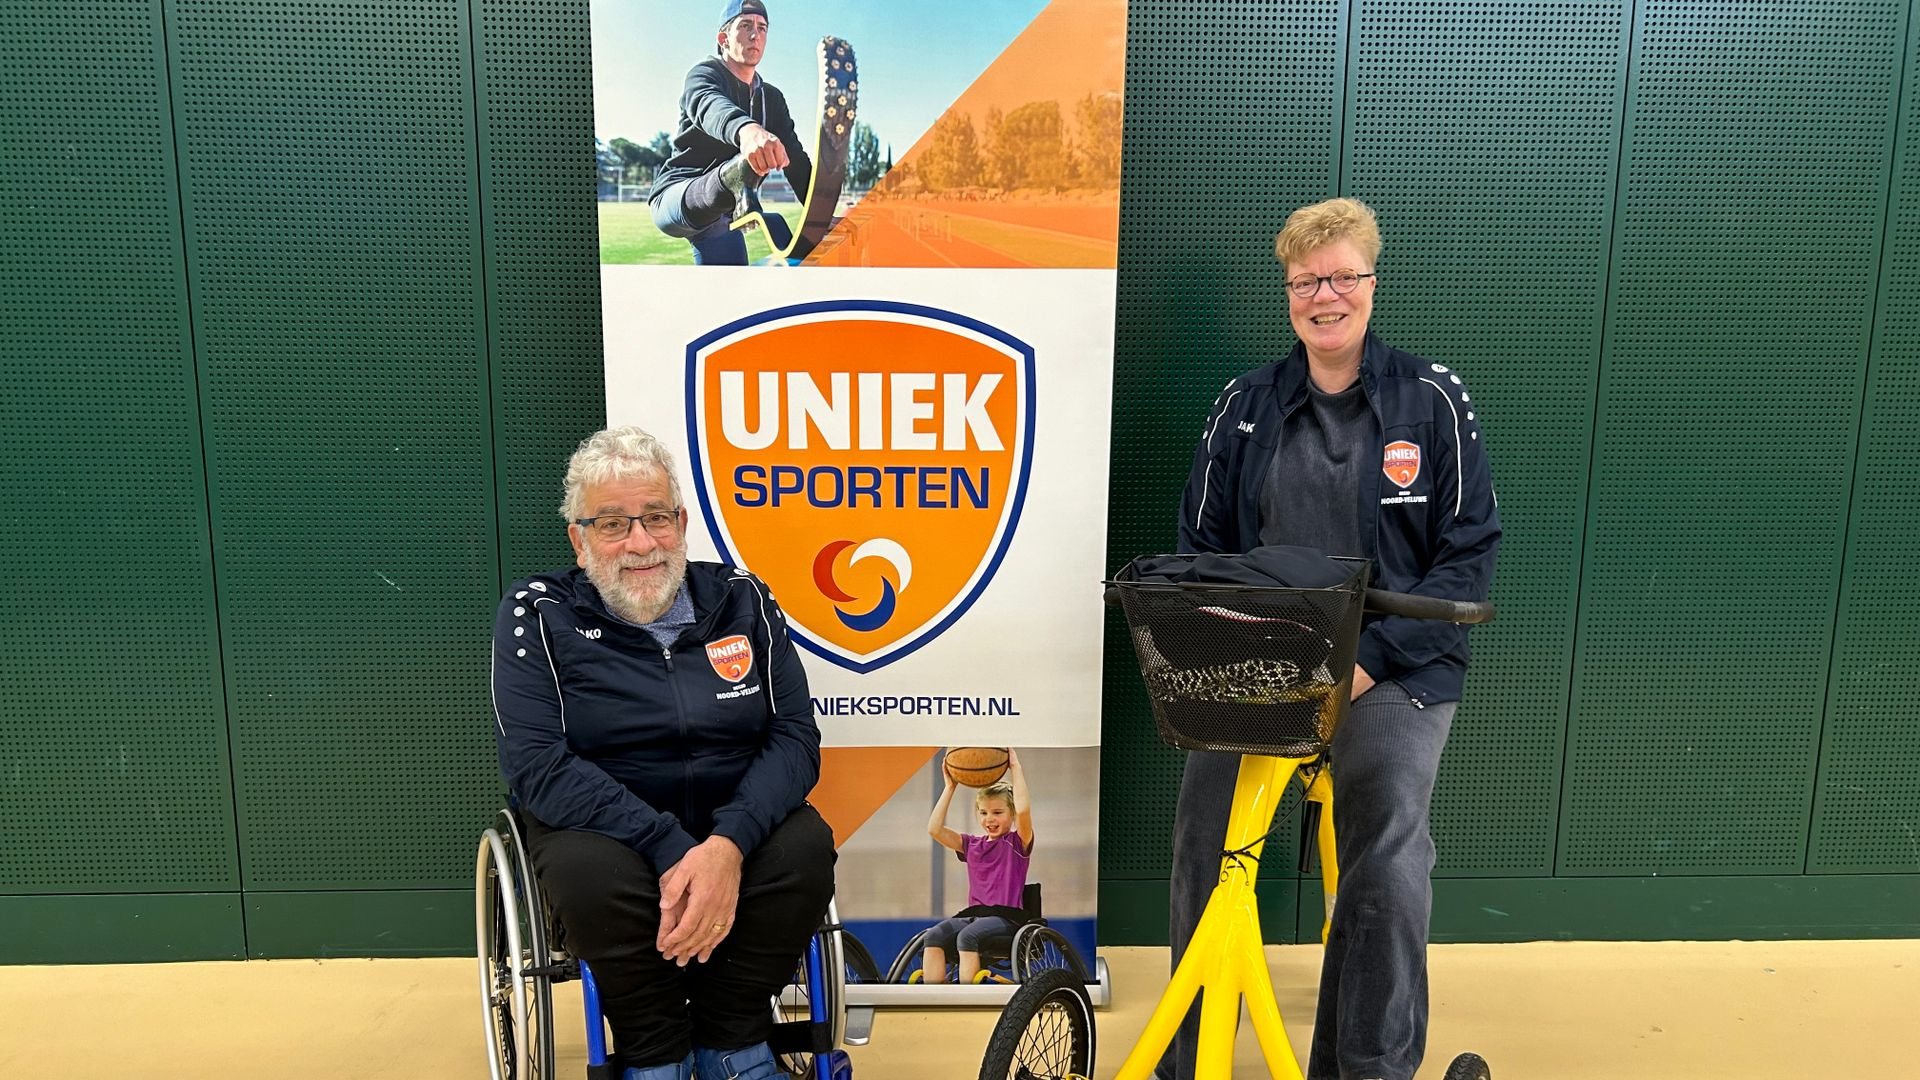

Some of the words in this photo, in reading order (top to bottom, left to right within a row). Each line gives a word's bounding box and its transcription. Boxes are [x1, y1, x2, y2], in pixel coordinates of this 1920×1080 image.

[719, 370, 1005, 451] UNIEK
[1237, 420, 1256, 433] JAK
[1384, 448, 1418, 461] UNIEK
[733, 464, 990, 509] SPORTEN
[575, 626, 602, 640] AKO
[708, 639, 749, 659] UNIEK
[713, 651, 749, 666] SPORTEN
[810, 696, 1020, 716] NIEKSPORTEN.NL
